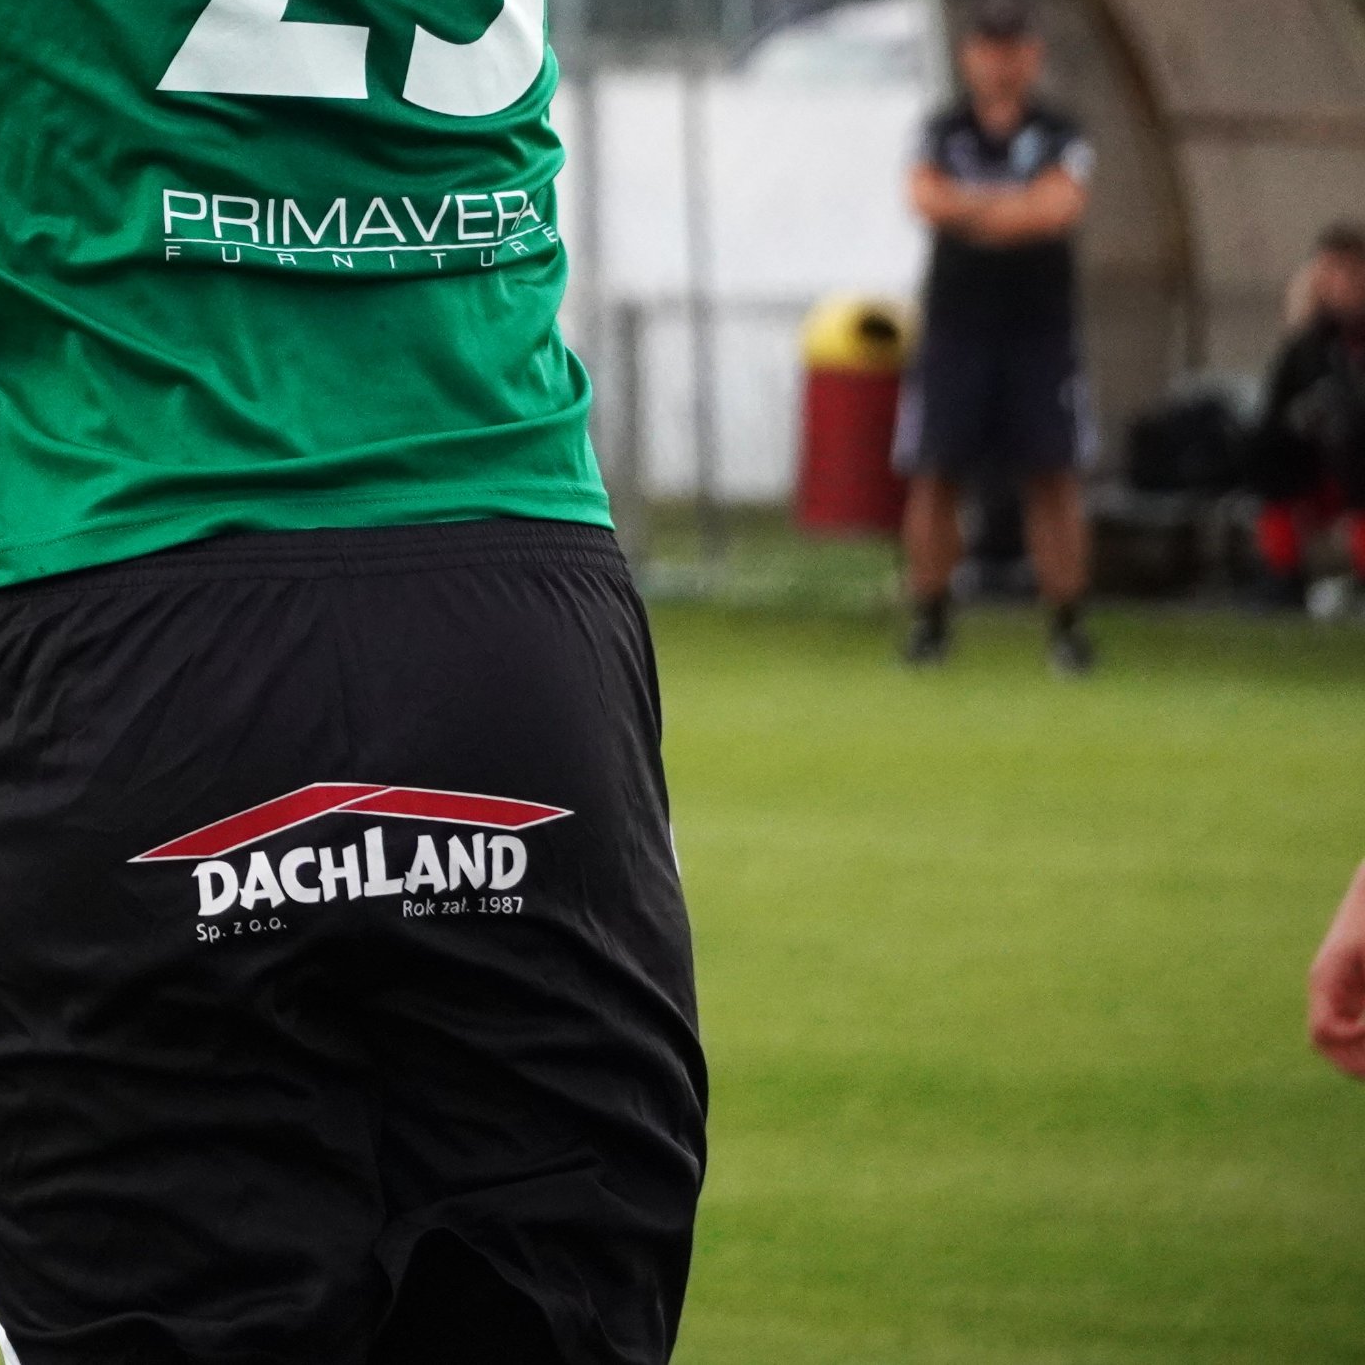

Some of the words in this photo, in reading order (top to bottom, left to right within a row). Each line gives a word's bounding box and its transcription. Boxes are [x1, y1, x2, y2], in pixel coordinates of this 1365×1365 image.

[165, 226, 558, 270] FURNITURE
[191, 826, 527, 917] DACHLAND
[402, 899, 435, 918] Rok
[441, 898, 470, 915] zał.
[477, 896, 524, 915] 1987
[196, 923, 226, 943] Sp.
[234, 922, 243, 935] z
[248, 915, 287, 933] o.o.
